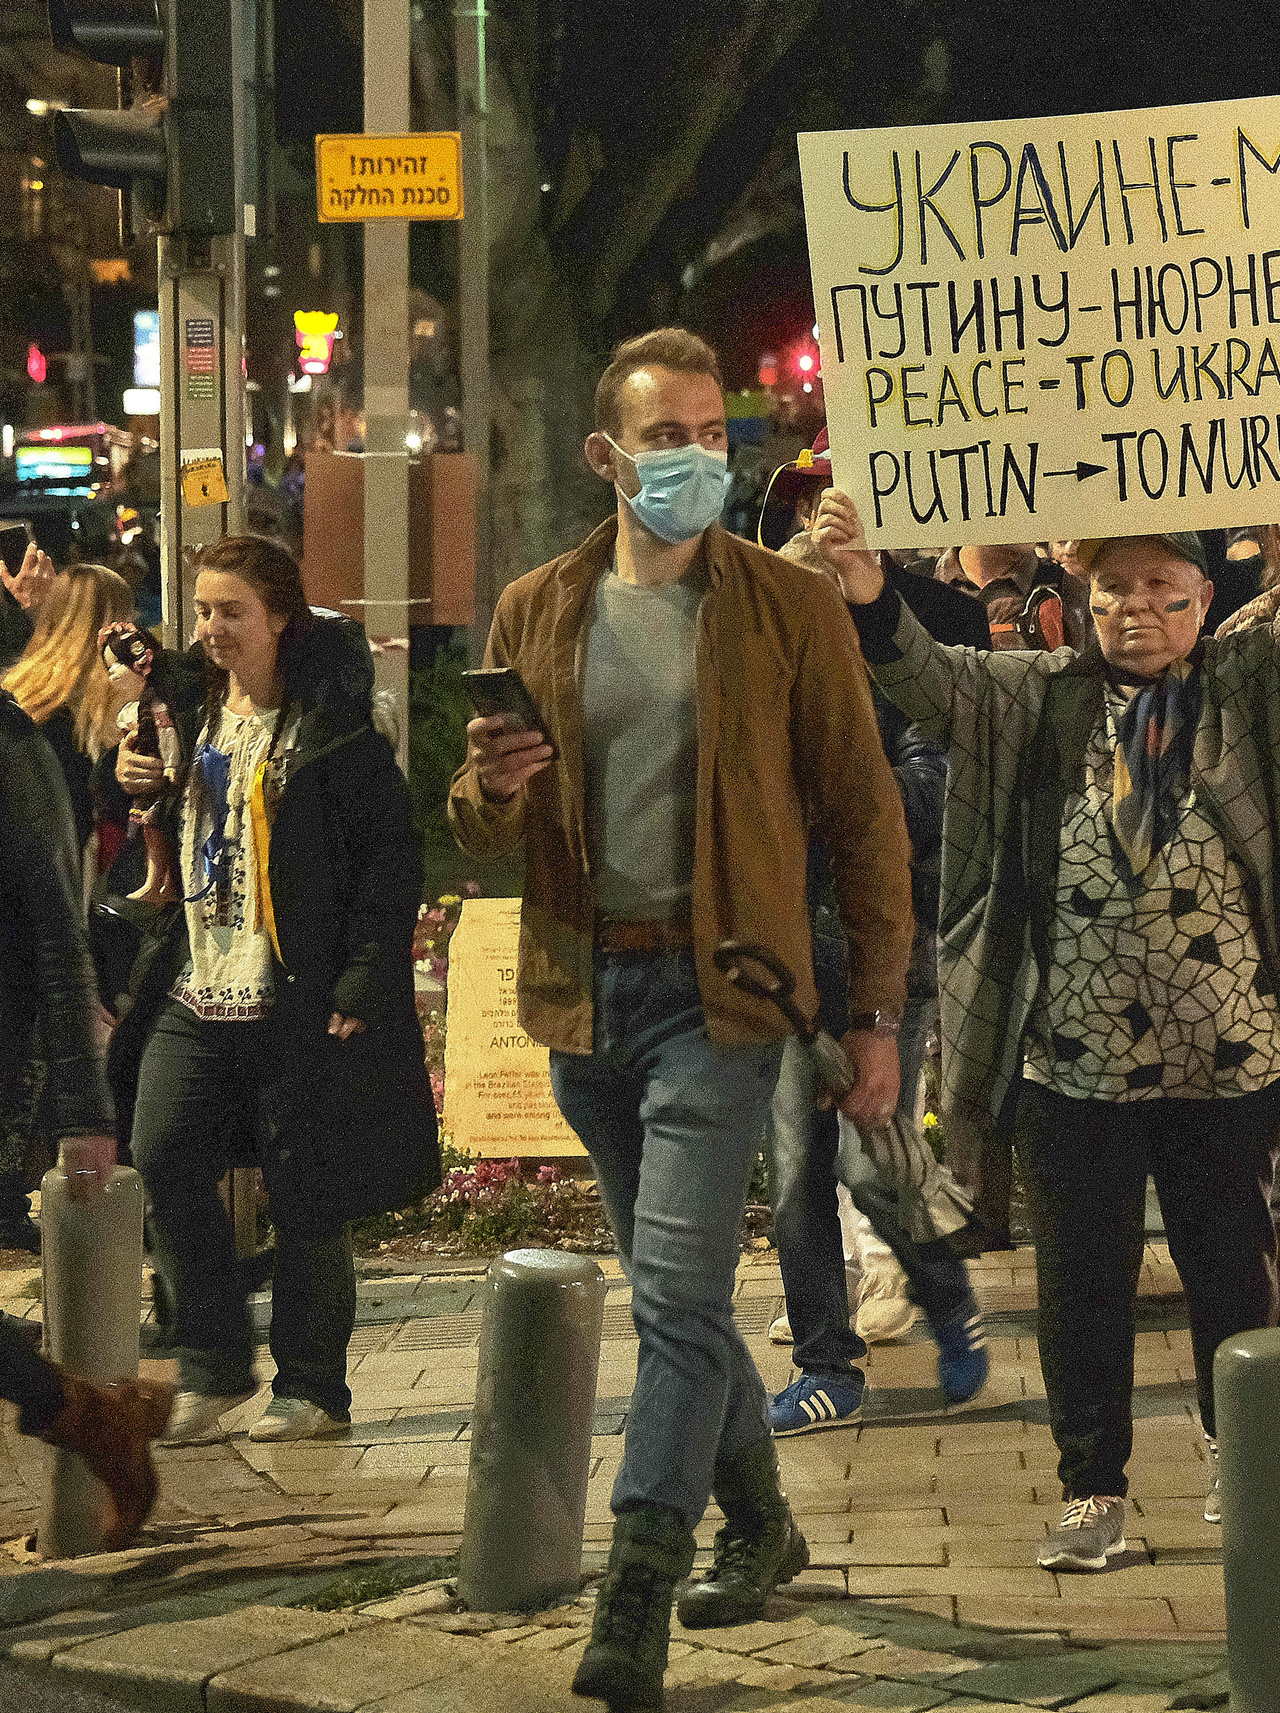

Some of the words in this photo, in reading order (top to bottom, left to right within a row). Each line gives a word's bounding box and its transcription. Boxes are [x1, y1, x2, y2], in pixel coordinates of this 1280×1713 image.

[351, 155, 428, 176] זהירות!
[330, 184, 395, 211] החלקה
[402, 186, 450, 205] סכנת
[868, 441, 1040, 529] PUTIN
